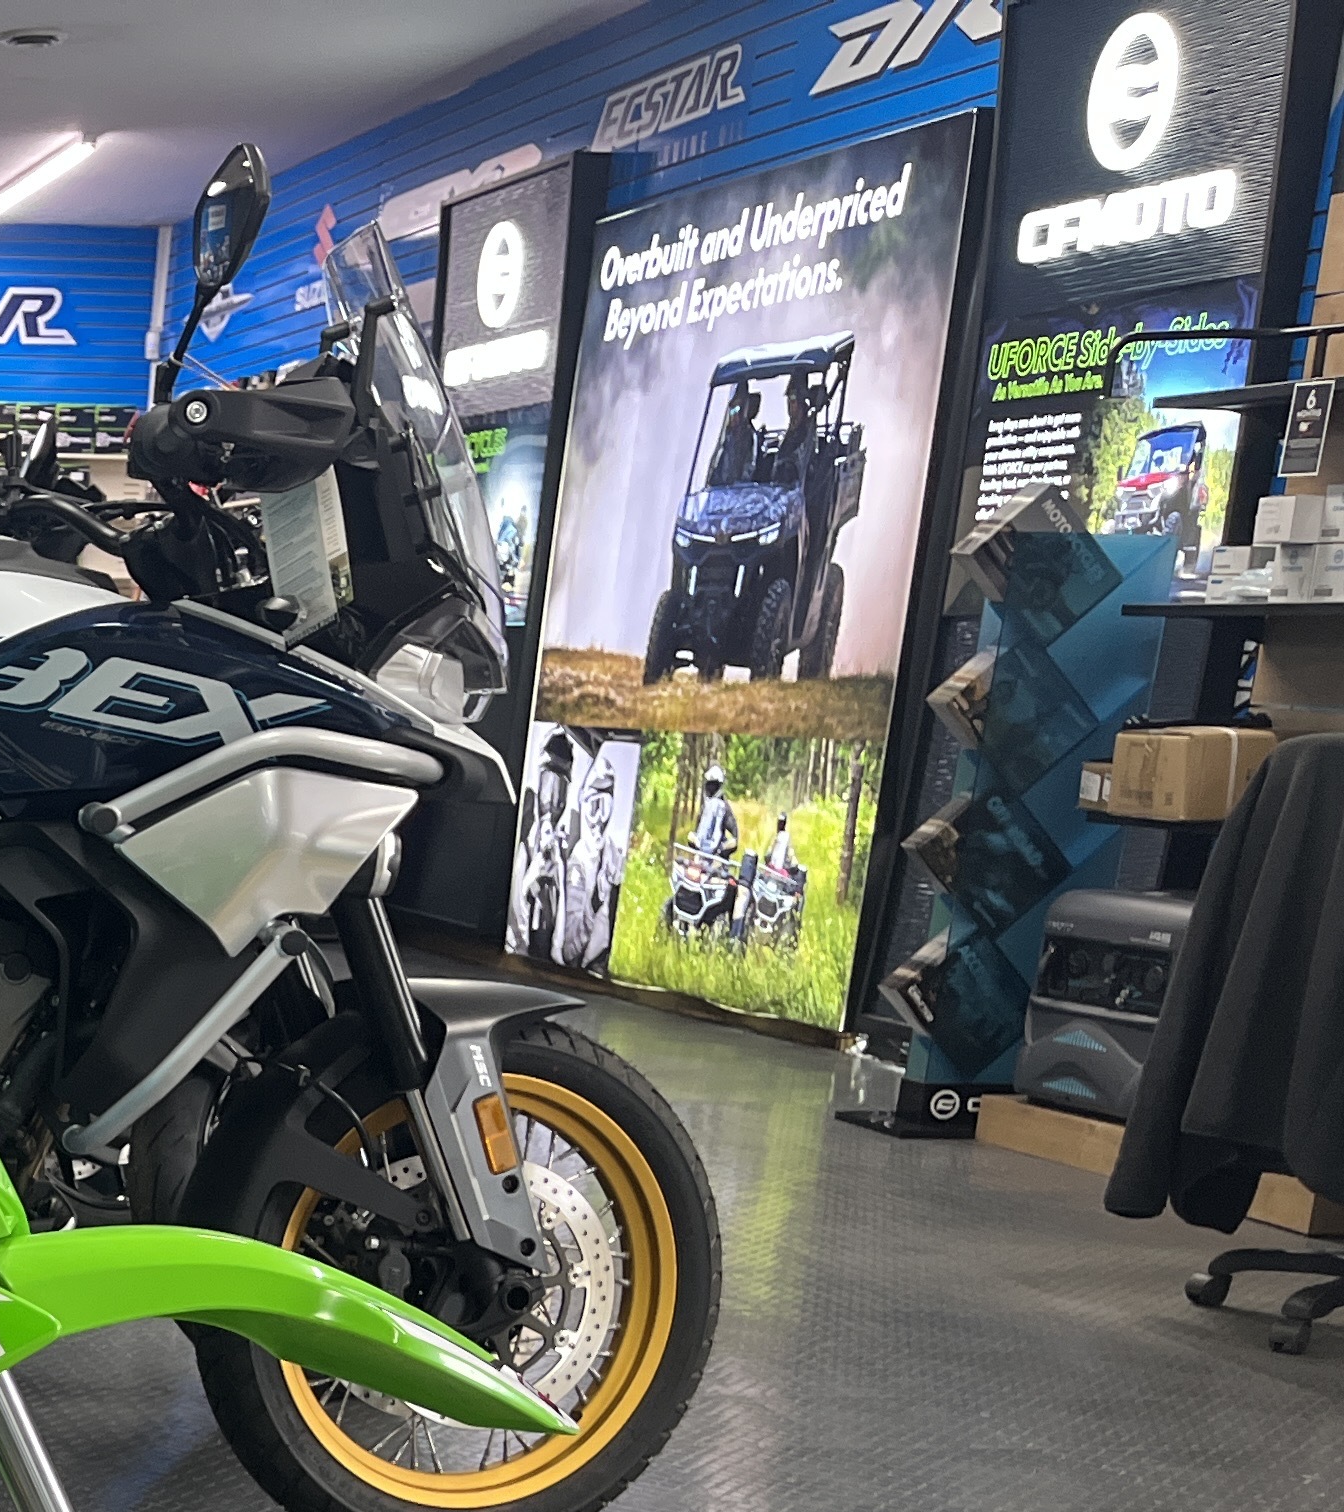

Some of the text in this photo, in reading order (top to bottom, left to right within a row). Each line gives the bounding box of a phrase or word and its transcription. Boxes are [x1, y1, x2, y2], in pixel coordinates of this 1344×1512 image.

[591, 44, 745, 152] ECSTAR
[600, 162, 912, 291] Overbuilt and Underpriced
[1017, 169, 1238, 264] CFMOTO
[604, 254, 843, 350] Beyond Expectations.
[987, 331, 1079, 380] UFORCE
[1306, 387, 1317, 410] 6
